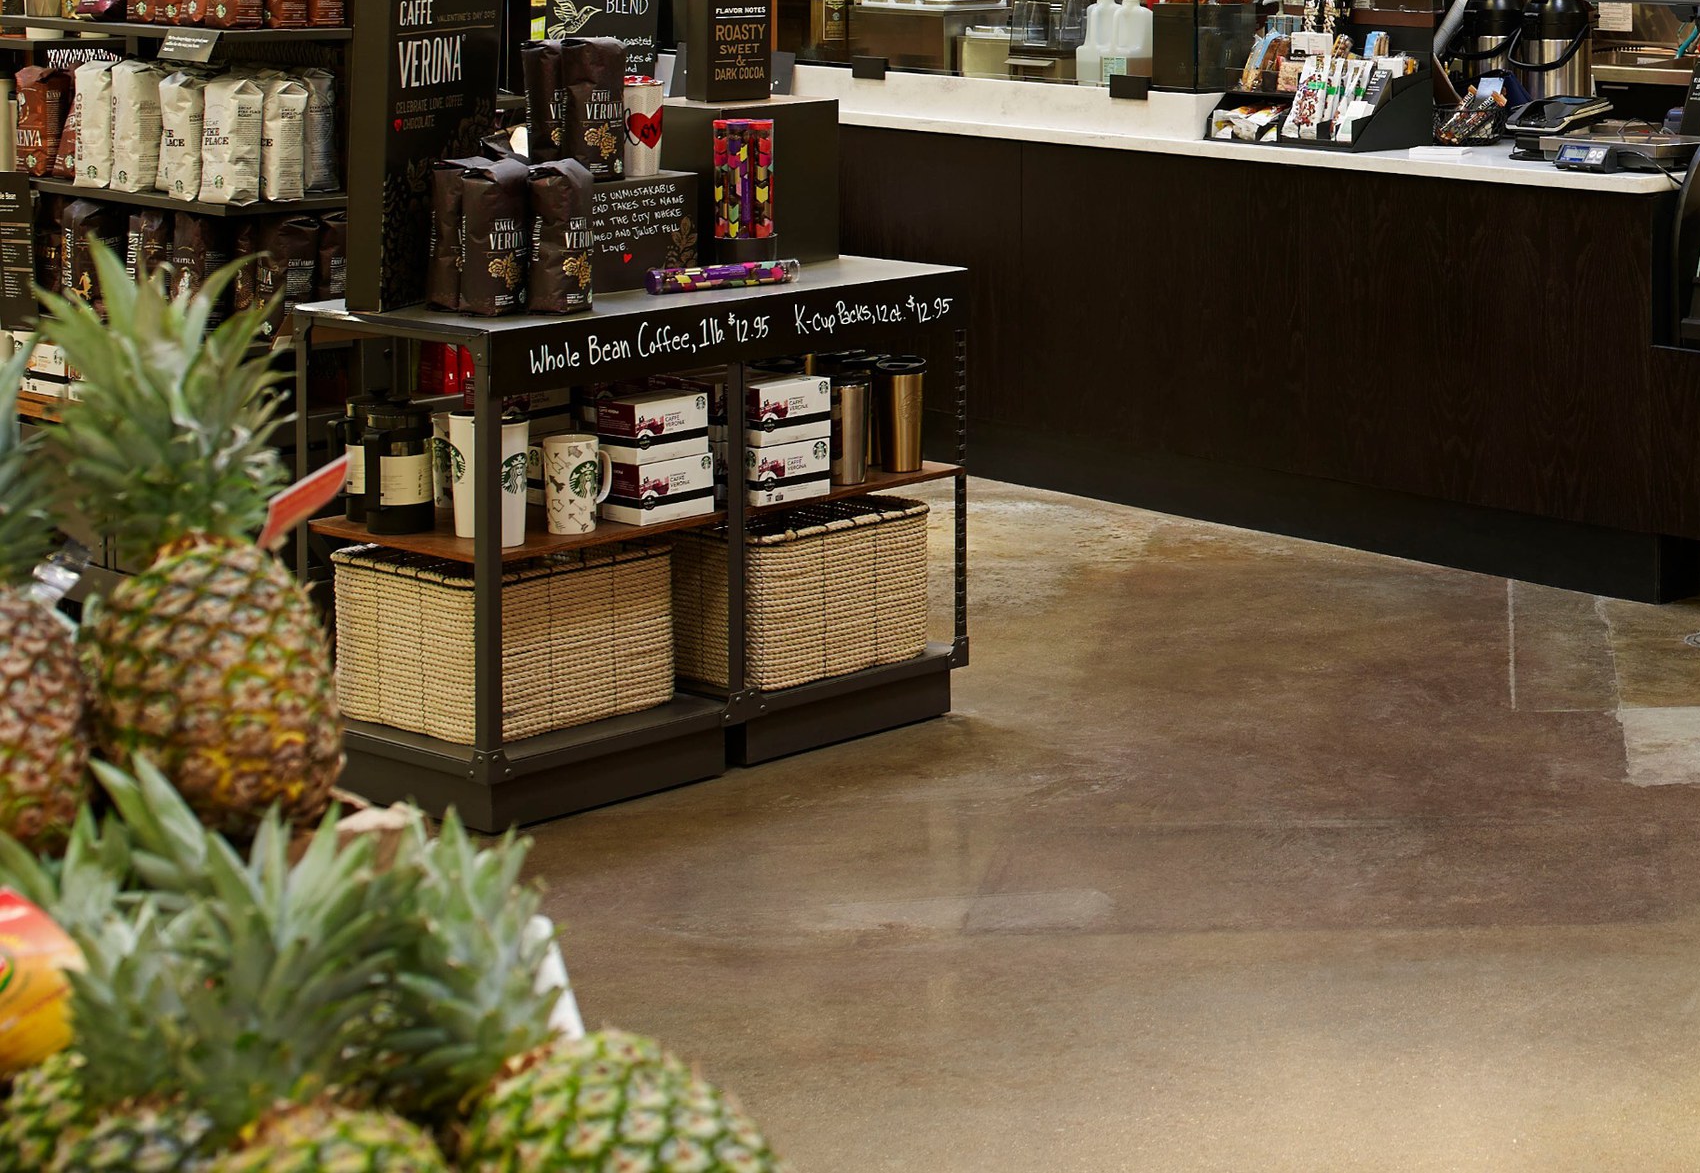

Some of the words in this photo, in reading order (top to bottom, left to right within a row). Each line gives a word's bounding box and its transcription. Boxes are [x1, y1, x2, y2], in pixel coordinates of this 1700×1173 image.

[744, 6, 766, 14] NOTES
[715, 23, 766, 41] ROASTY
[719, 43, 760, 54] SWEET
[398, 35, 462, 89] VERONA
[735, 55, 747, 67] &
[715, 68, 737, 81] DARK
[739, 66, 765, 79] COCOA
[205, 136, 229, 146] PLACE
[610, 183, 676, 200] UNMISTAKABLE
[612, 200, 639, 210] TAKES
[642, 198, 656, 207] ITS
[660, 194, 685, 206] NAME
[610, 215, 629, 225] THE
[632, 212, 650, 225] CITY
[654, 208, 682, 220] WHERE
[615, 229, 631, 238] AND
[632, 224, 659, 240] JULIET
[661, 223, 680, 233] FELL
[835, 300, 876, 325] Packs,
[905, 295, 953, 324] $12.95
[530, 342, 580, 374] Whole
[588, 335, 631, 365] Bean
[638, 321, 697, 358] Coffee,
[728, 312, 770, 342] $12.95
